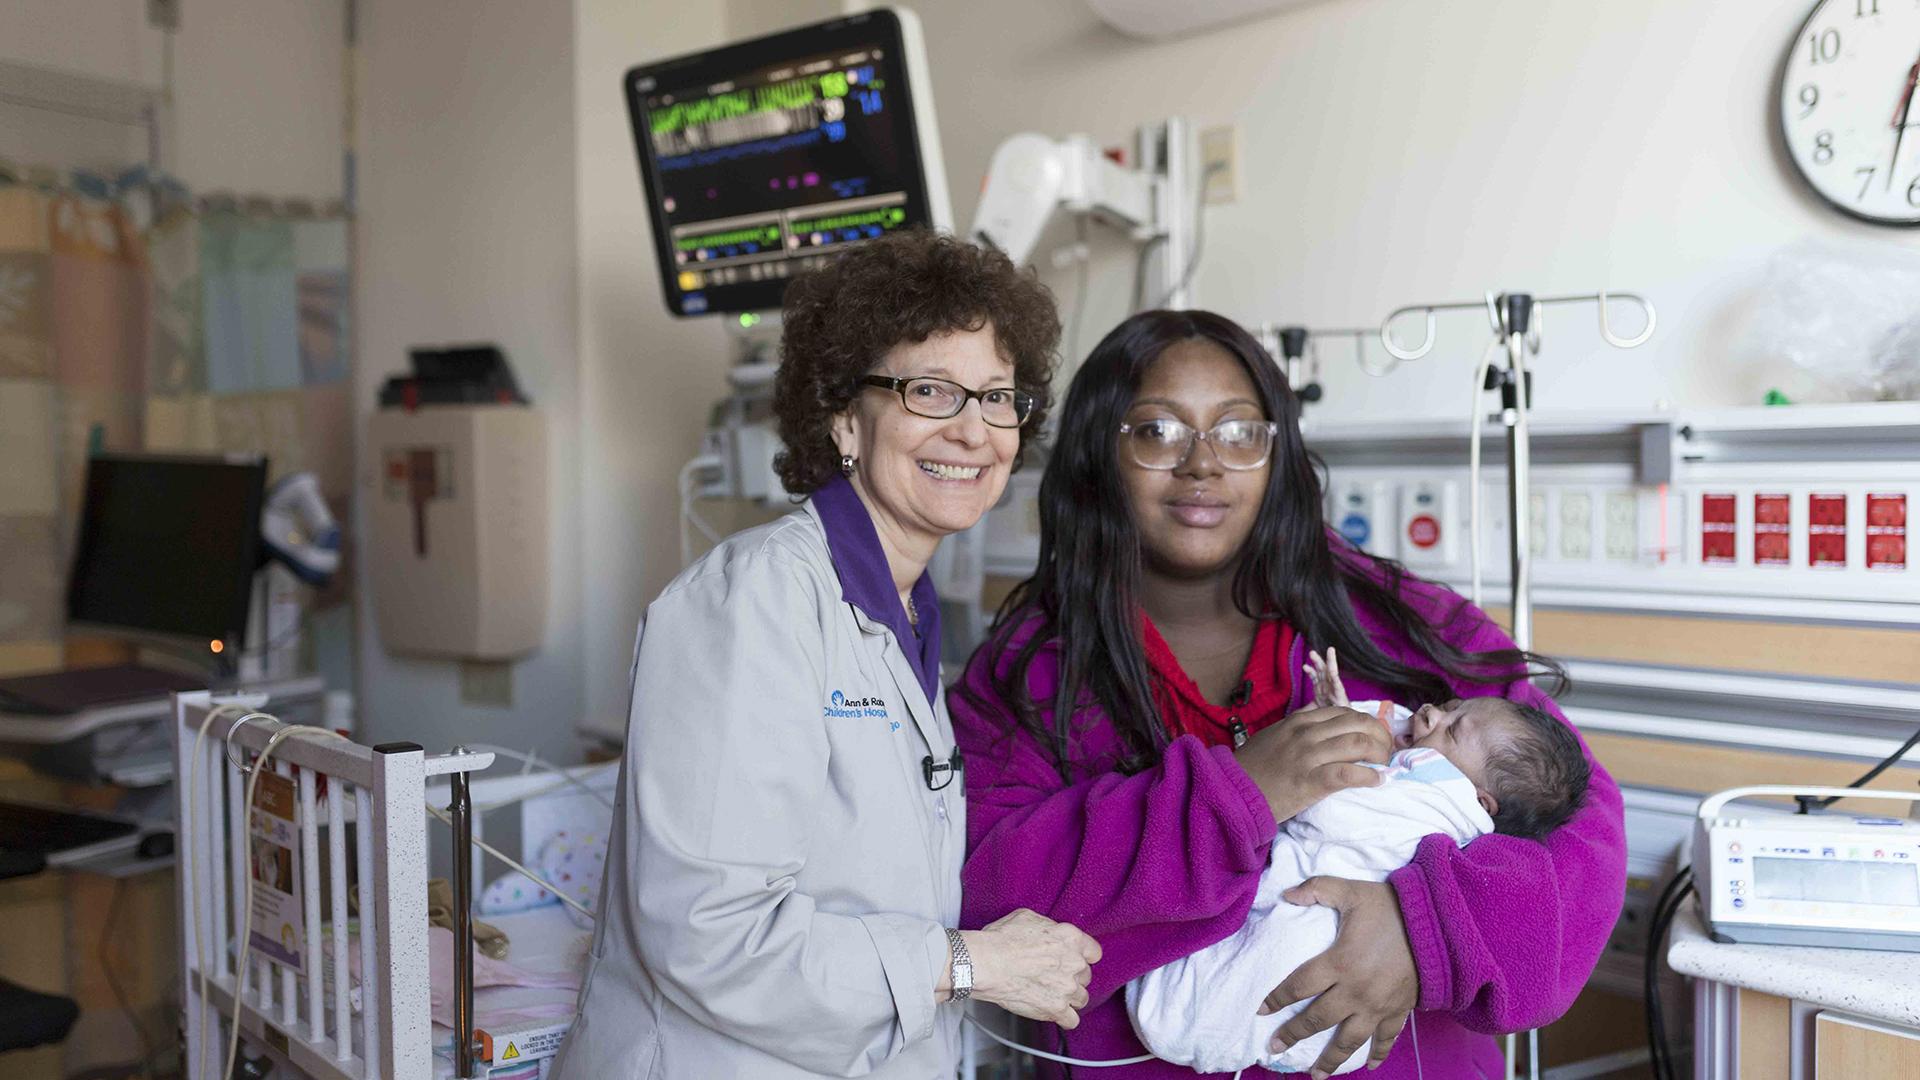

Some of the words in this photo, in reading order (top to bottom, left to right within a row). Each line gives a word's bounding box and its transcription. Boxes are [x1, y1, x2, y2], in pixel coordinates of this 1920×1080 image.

[1810, 29, 1841, 65] 10
[1799, 83, 1820, 120] 9
[1813, 130, 1834, 165] 8
[1855, 166, 1876, 201] 7
[824, 707, 862, 718] Children's
[845, 699, 861, 707] Ann
[862, 697, 870, 707] &
